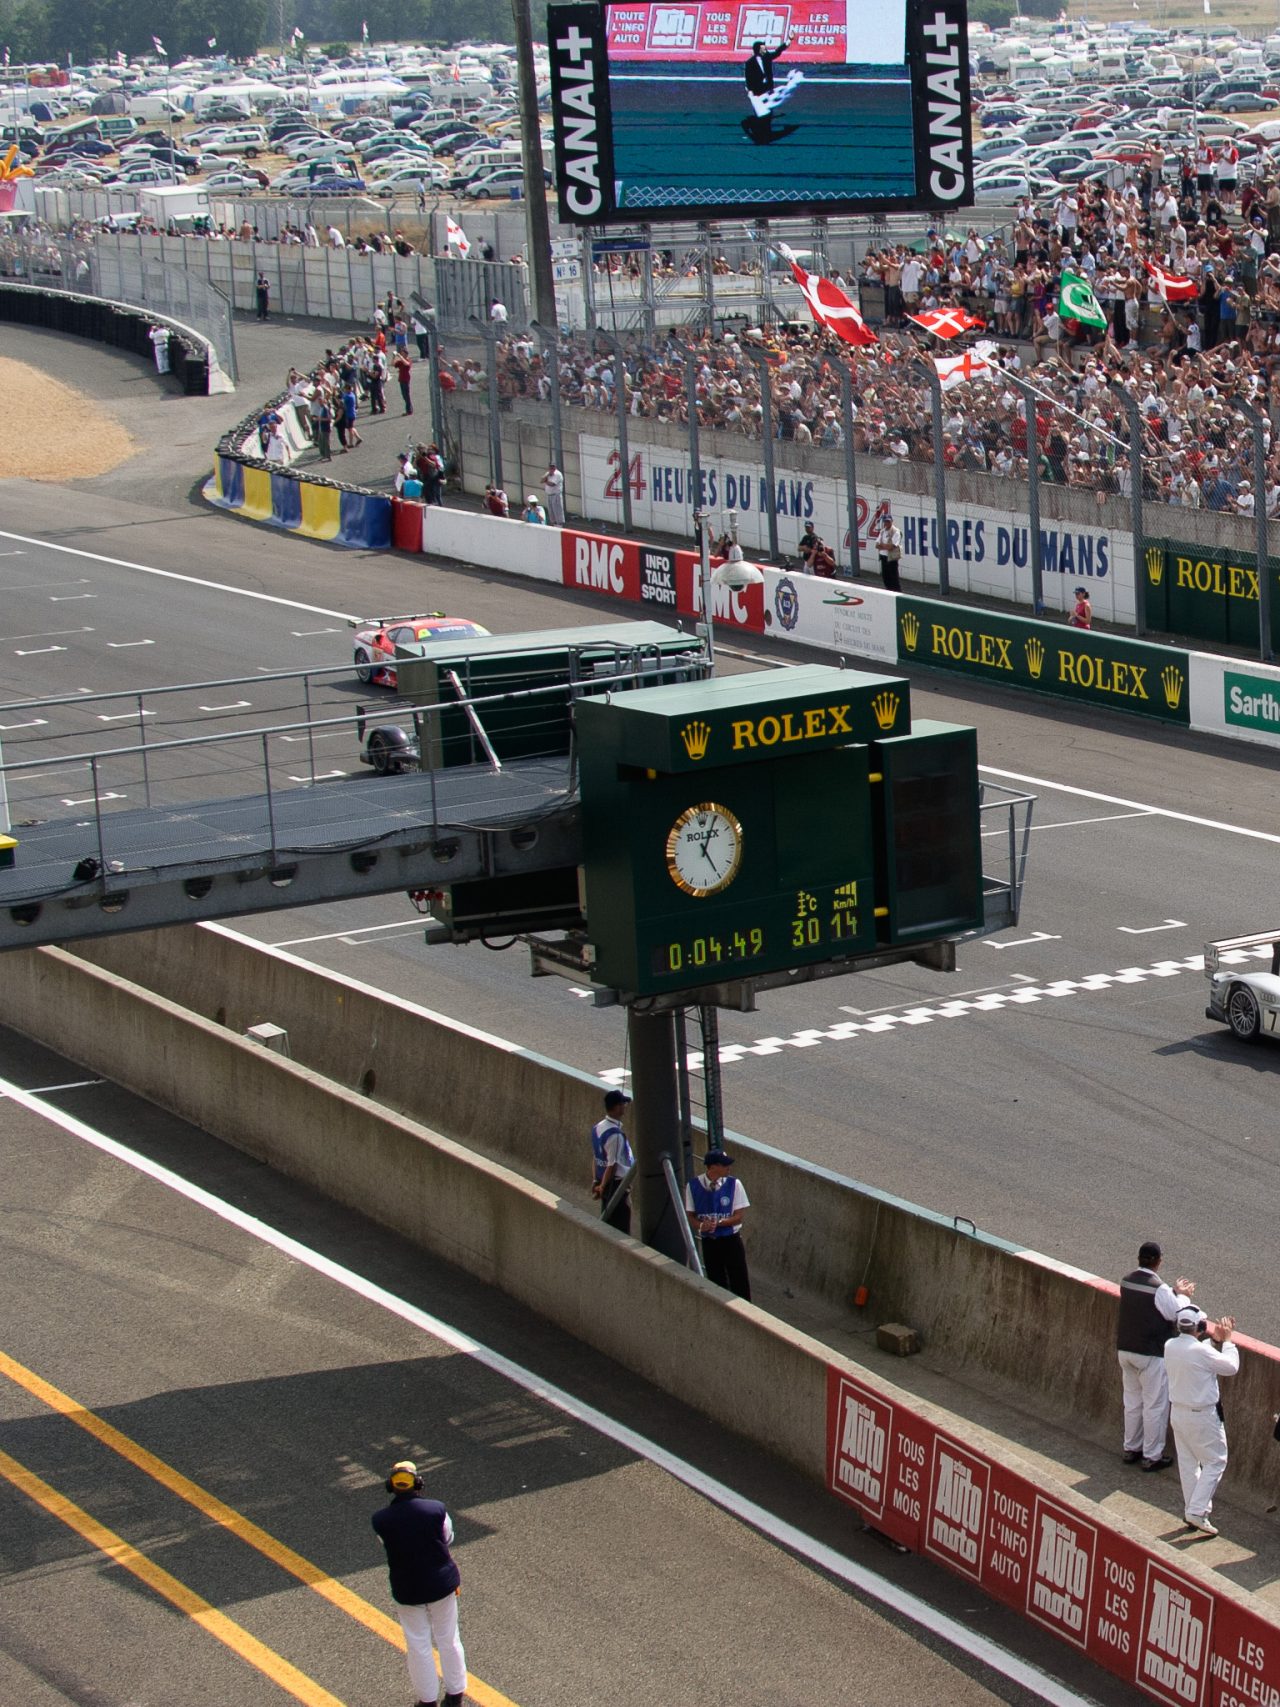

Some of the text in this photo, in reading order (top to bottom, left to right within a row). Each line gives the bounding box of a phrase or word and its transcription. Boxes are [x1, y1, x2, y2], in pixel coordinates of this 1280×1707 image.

[612, 22, 645, 33] L'INFO
[614, 11, 645, 21] TOUTE
[706, 13, 731, 22] TOUS
[708, 24, 726, 33] LES
[790, 24, 847, 34] MEILLEURS
[810, 14, 829, 23] LES
[614, 34, 640, 44] AUTO
[703, 35, 728, 44] MOIS
[798, 36, 834, 45] ESSAIS
[556, 26, 600, 216] CANAL+
[923, 12, 964, 200] CANAL+
[569, 265, 577, 276] 16
[603, 449, 647, 500] 24
[726, 474, 750, 511] DU
[646, 554, 670, 572] INFO
[904, 516, 984, 563] HEURES
[997, 527, 1028, 568] DU
[1040, 530, 1108, 577] MANS
[576, 537, 624, 593] RMC
[645, 570, 671, 588] TALK
[1177, 557, 1260, 600] ROLEX
[641, 584, 676, 605] SPORT
[931, 624, 1013, 670] ROLEX
[1058, 651, 1148, 699] ROLEX
[732, 705, 853, 750] ROLEX
[687, 829, 719, 842] ROLEX
[792, 918, 819, 946] 30
[831, 911, 857, 938] 14
[669, 928, 762, 970] 0:04:49
[1268, 1010, 1276, 1031] 7
[841, 1395, 885, 1474] Auto
[898, 1433, 925, 1467] TOUS
[838, 1458, 881, 1503] moto
[899, 1463, 919, 1492] LES
[935, 1451, 982, 1535] Auto
[893, 1488, 921, 1522] MOIS
[993, 1490, 1029, 1529] TOUTE
[932, 1517, 977, 1565] moto
[990, 1518, 1027, 1558] L'INFO
[990, 1550, 1020, 1584] AUTO
[1036, 1513, 1088, 1600] Auto
[1103, 1557, 1135, 1594] TOUS
[1033, 1581, 1082, 1632] moto
[1105, 1590, 1128, 1622] LES
[1098, 1617, 1130, 1654] MOIS
[1147, 1579, 1203, 1671] Auto
[1238, 1637, 1264, 1671] LES
[1144, 1649, 1197, 1703] moto
